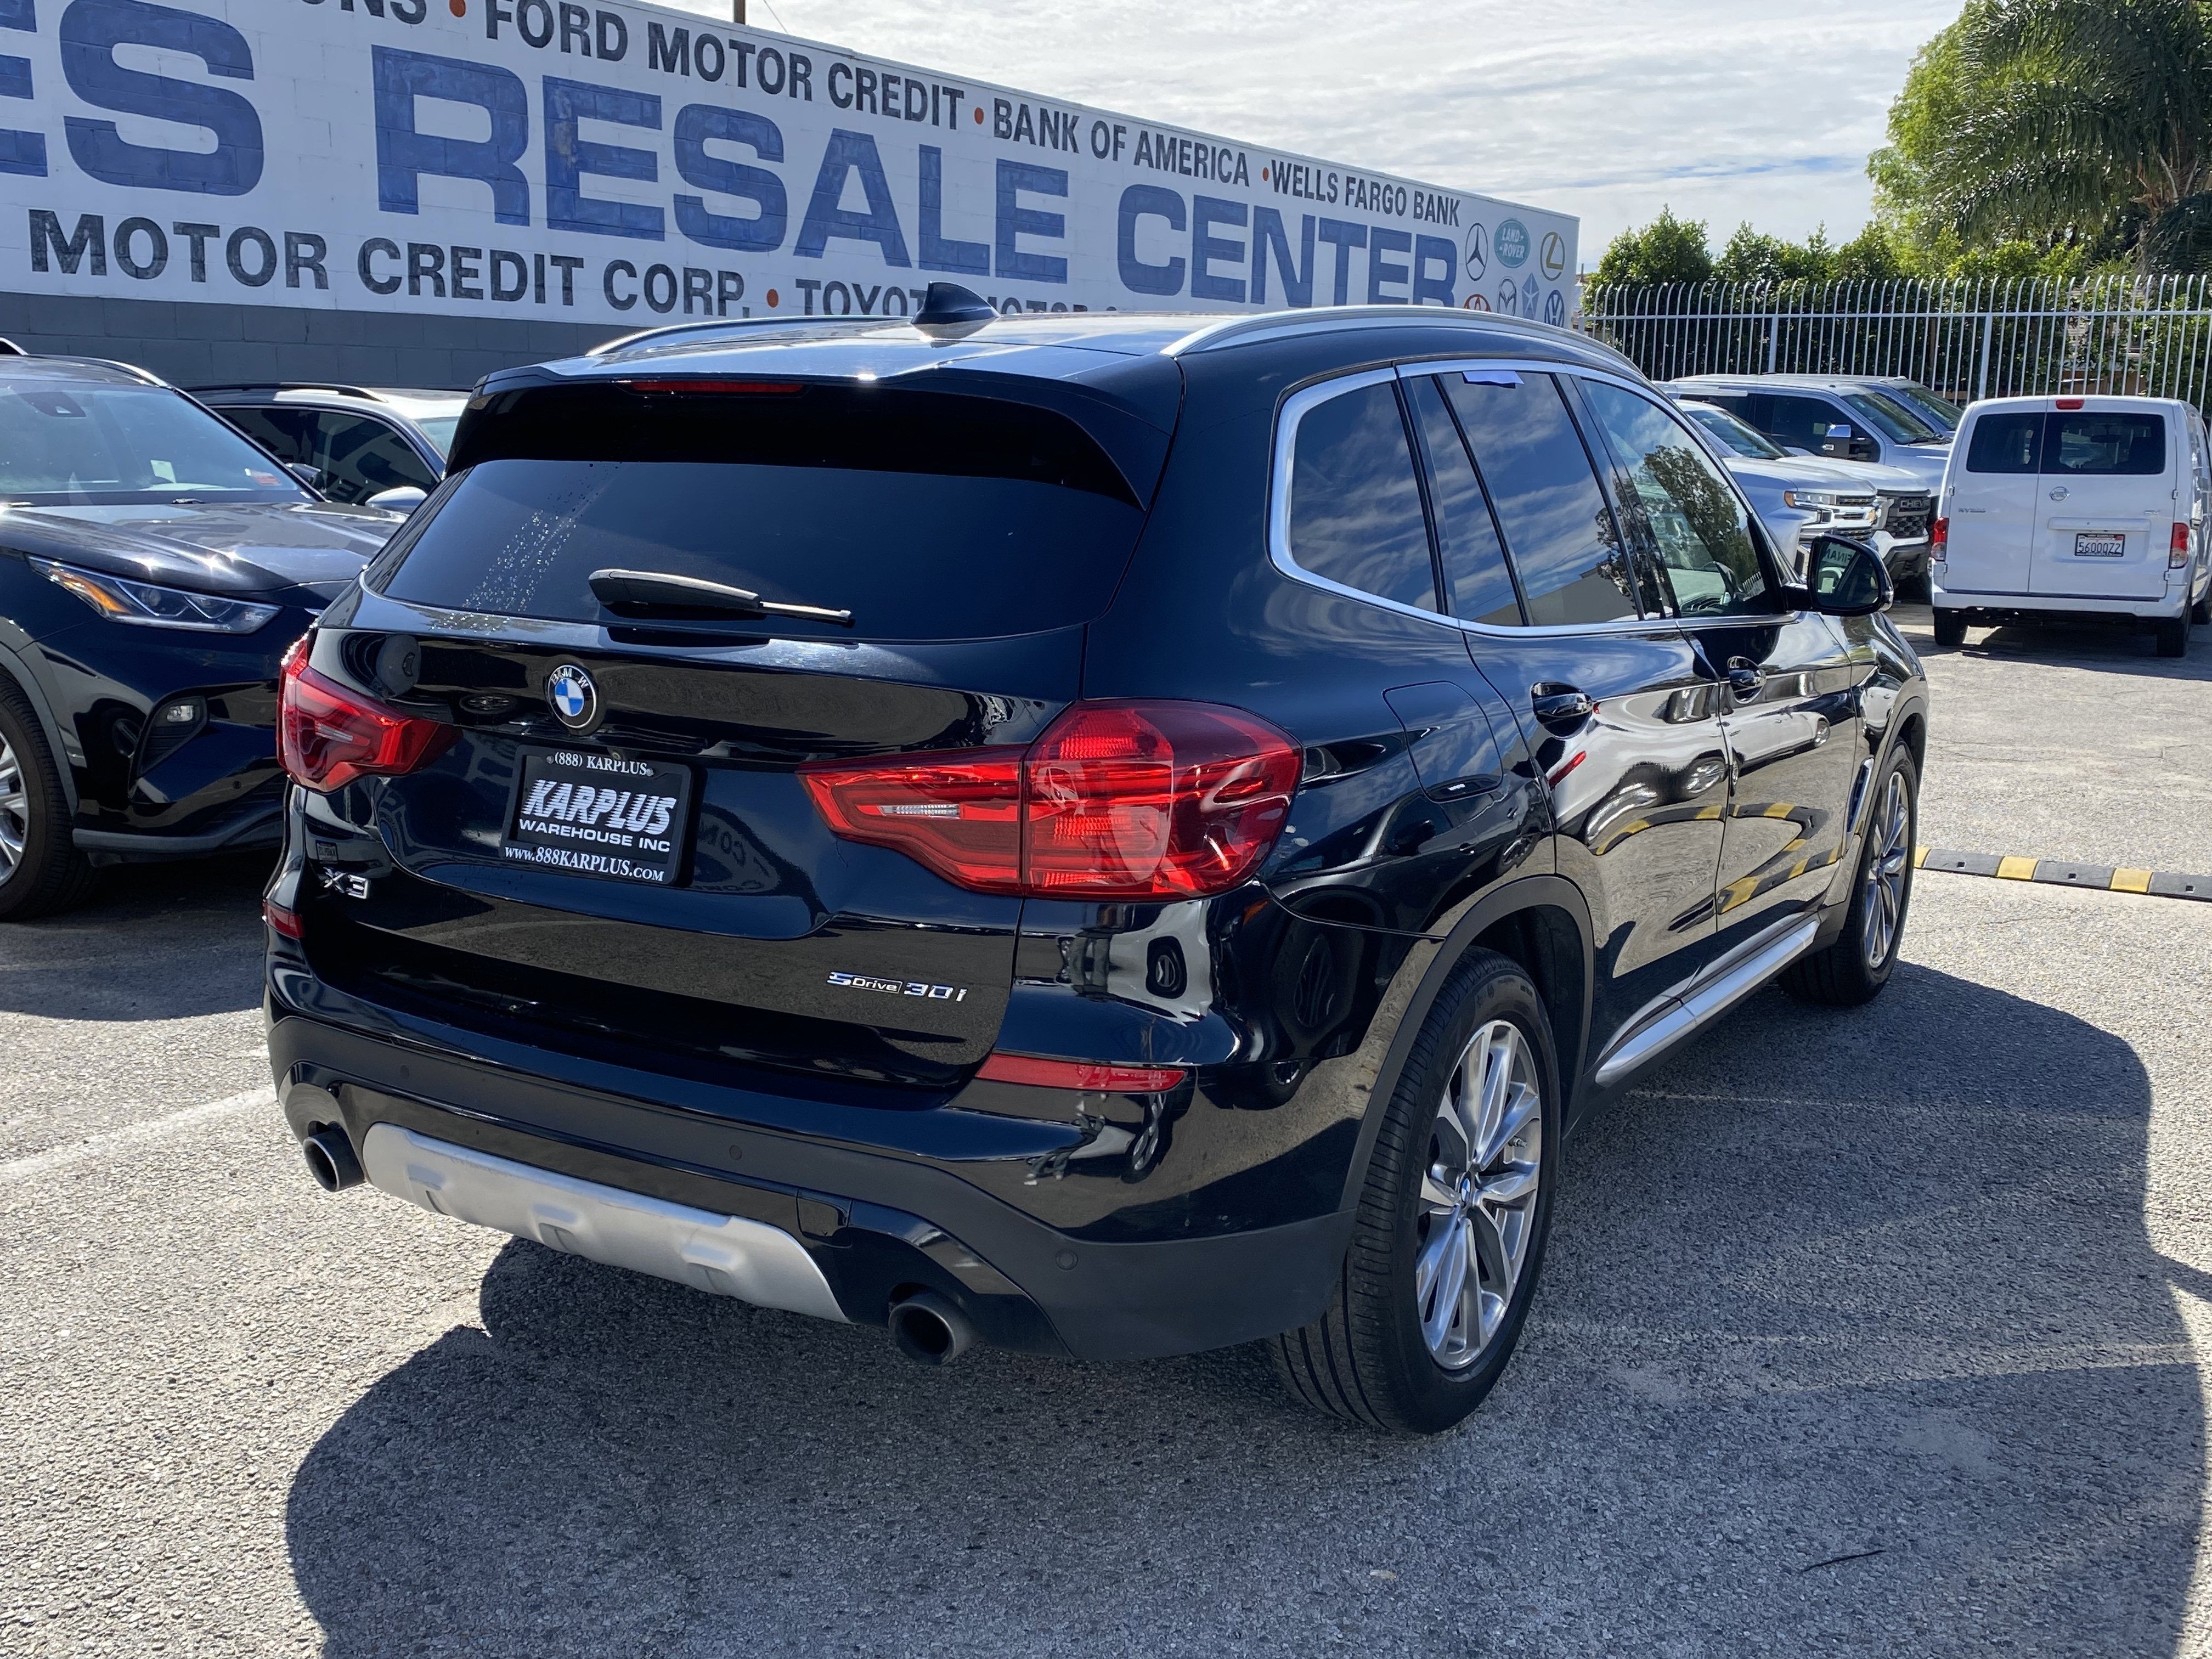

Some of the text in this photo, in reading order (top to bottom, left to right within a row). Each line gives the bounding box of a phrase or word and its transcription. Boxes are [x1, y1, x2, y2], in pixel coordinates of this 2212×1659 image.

[486, 0, 964, 131] FORD MOTOR CREDIT
[0, 0, 1457, 308] S RESALE CENTER
[994, 98, 1250, 187] BANK OF AMERICA
[1271, 159, 1460, 227] WELLS FARGO BANK
[1502, 227, 1520, 242] LAND
[1502, 242, 1525, 258] ROVER
[29, 209, 751, 319] MOTOR CREDIT CORP.
[551, 667, 589, 689] BMW
[555, 751, 648, 776] (888) KARPLUS
[520, 779, 677, 836] KARPLUS
[519, 819, 671, 853] WAREHOUSE INC
[323, 866, 369, 899] X3
